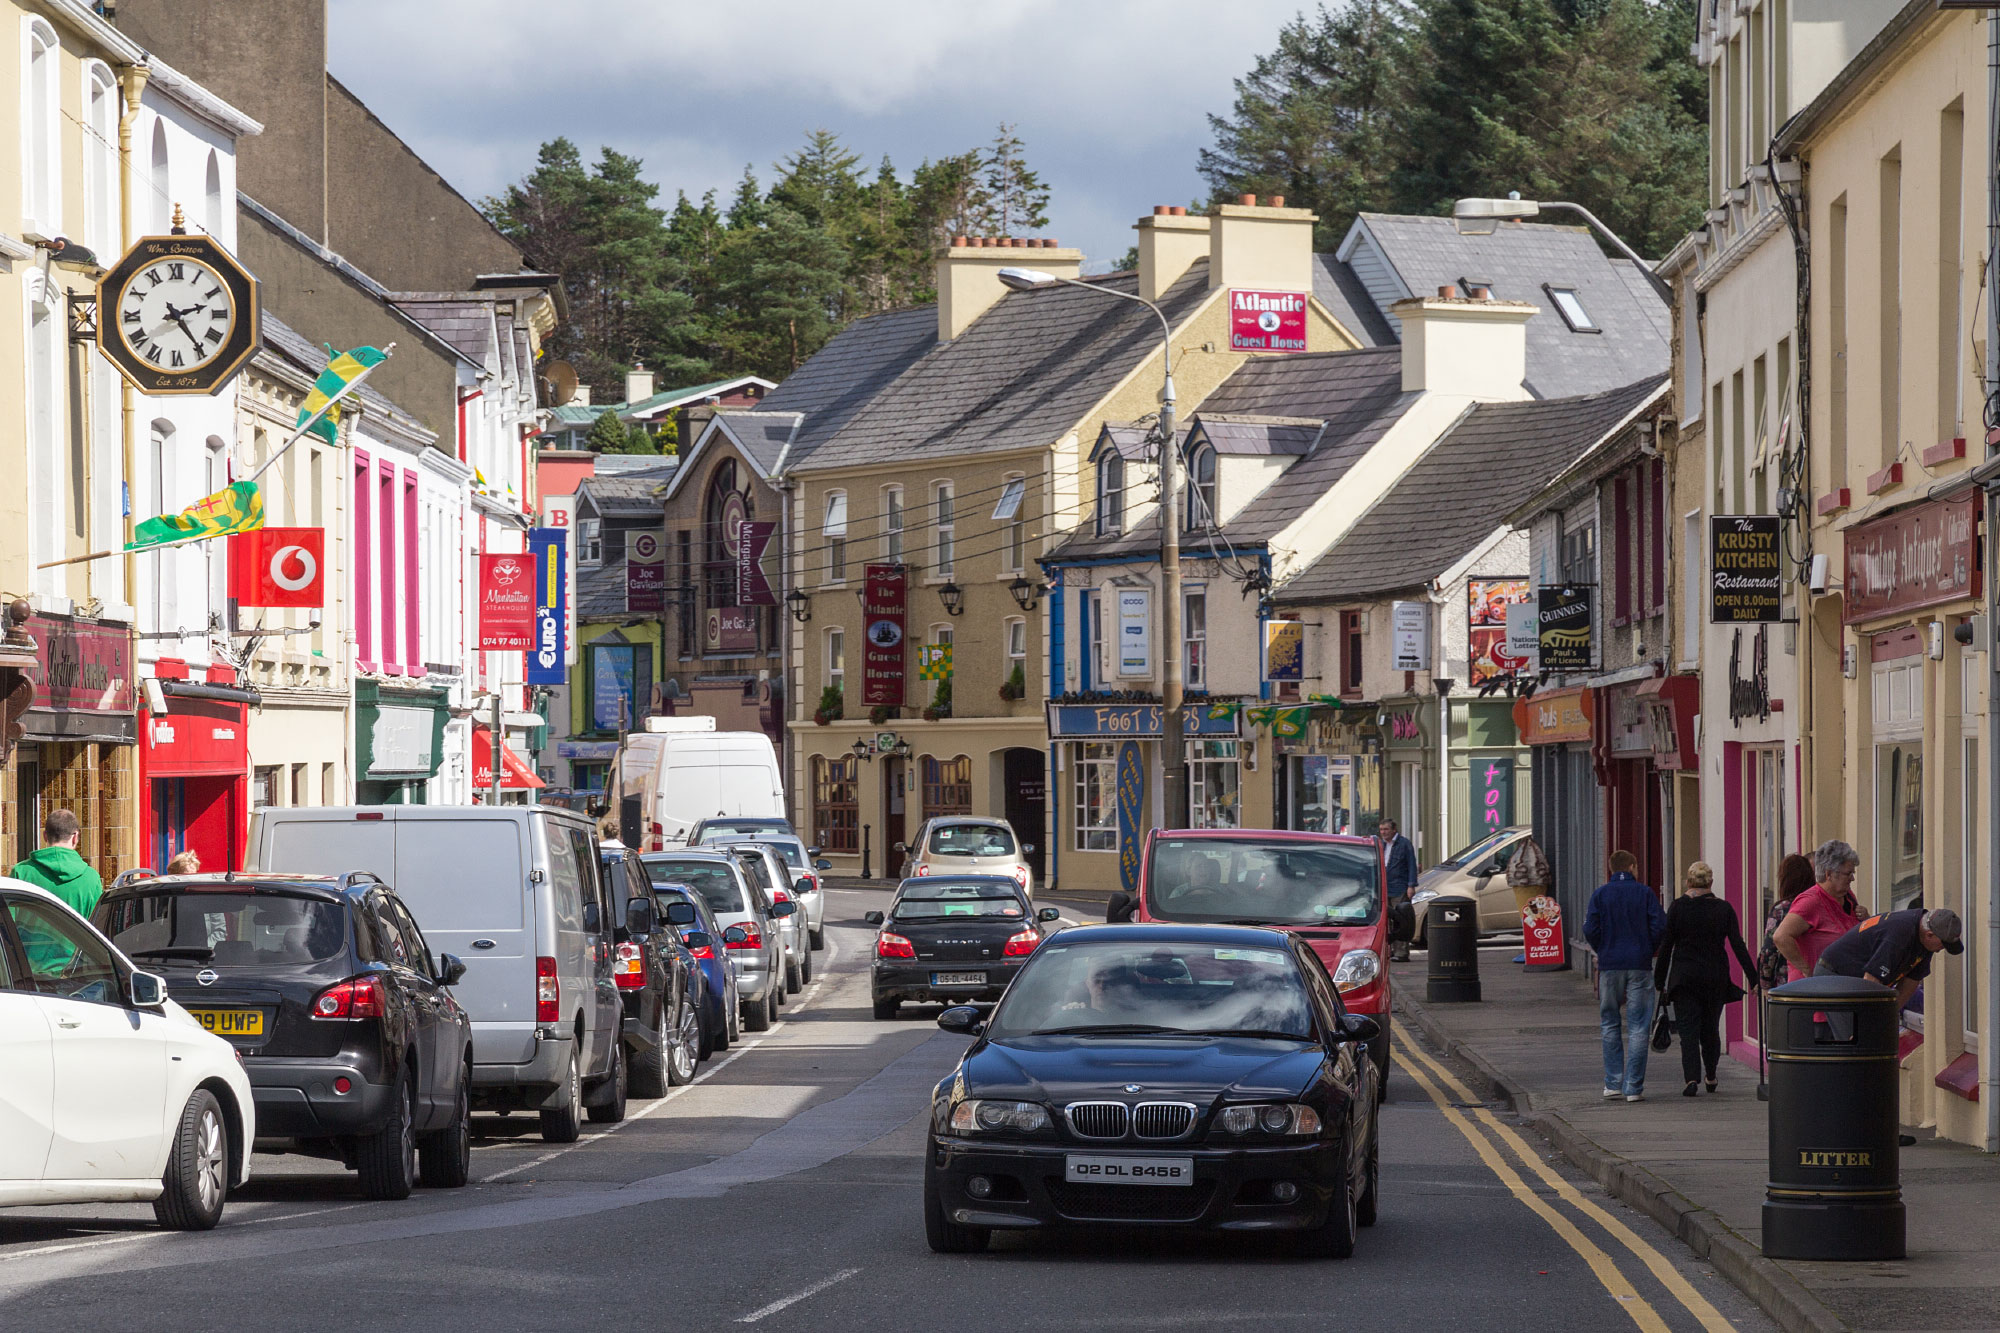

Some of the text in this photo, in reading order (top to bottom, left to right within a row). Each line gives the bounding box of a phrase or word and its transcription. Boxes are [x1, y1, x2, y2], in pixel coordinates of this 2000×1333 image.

[170, 243, 204, 254] Britton
[1233, 292, 1304, 313] Atlantic
[1233, 333, 1305, 350] Guest House
[156, 376, 172, 387] Est.
[1734, 519, 1754, 532] The
[1718, 532, 1774, 549] KRUSTY
[1715, 551, 1778, 569] KITCHEN
[638, 568, 655, 579] Joe
[1865, 533, 1897, 601] Vintage
[1714, 572, 1780, 590] Restaurant
[483, 588, 530, 604] Manhattan
[877, 587, 895, 598] The
[1714, 594, 1779, 606] OPEN 8.00am
[868, 604, 905, 615] Atlantic
[1540, 601, 1588, 623] GUINNESS
[1733, 607, 1761, 620] DAILY
[721, 616, 733, 630] Joe
[482, 637, 531, 646] 074 97 40111
[868, 651, 901, 662] Guest
[1553, 649, 1577, 657] Paul's
[1503, 660, 1517, 668] HB
[1544, 657, 1587, 665] Off Licence
[867, 668, 903, 679] House
[221, 1013, 258, 1031] UWP
[1800, 1151, 1871, 1166] LITTER
[1076, 1164, 1181, 1178] 02 DL 8458
